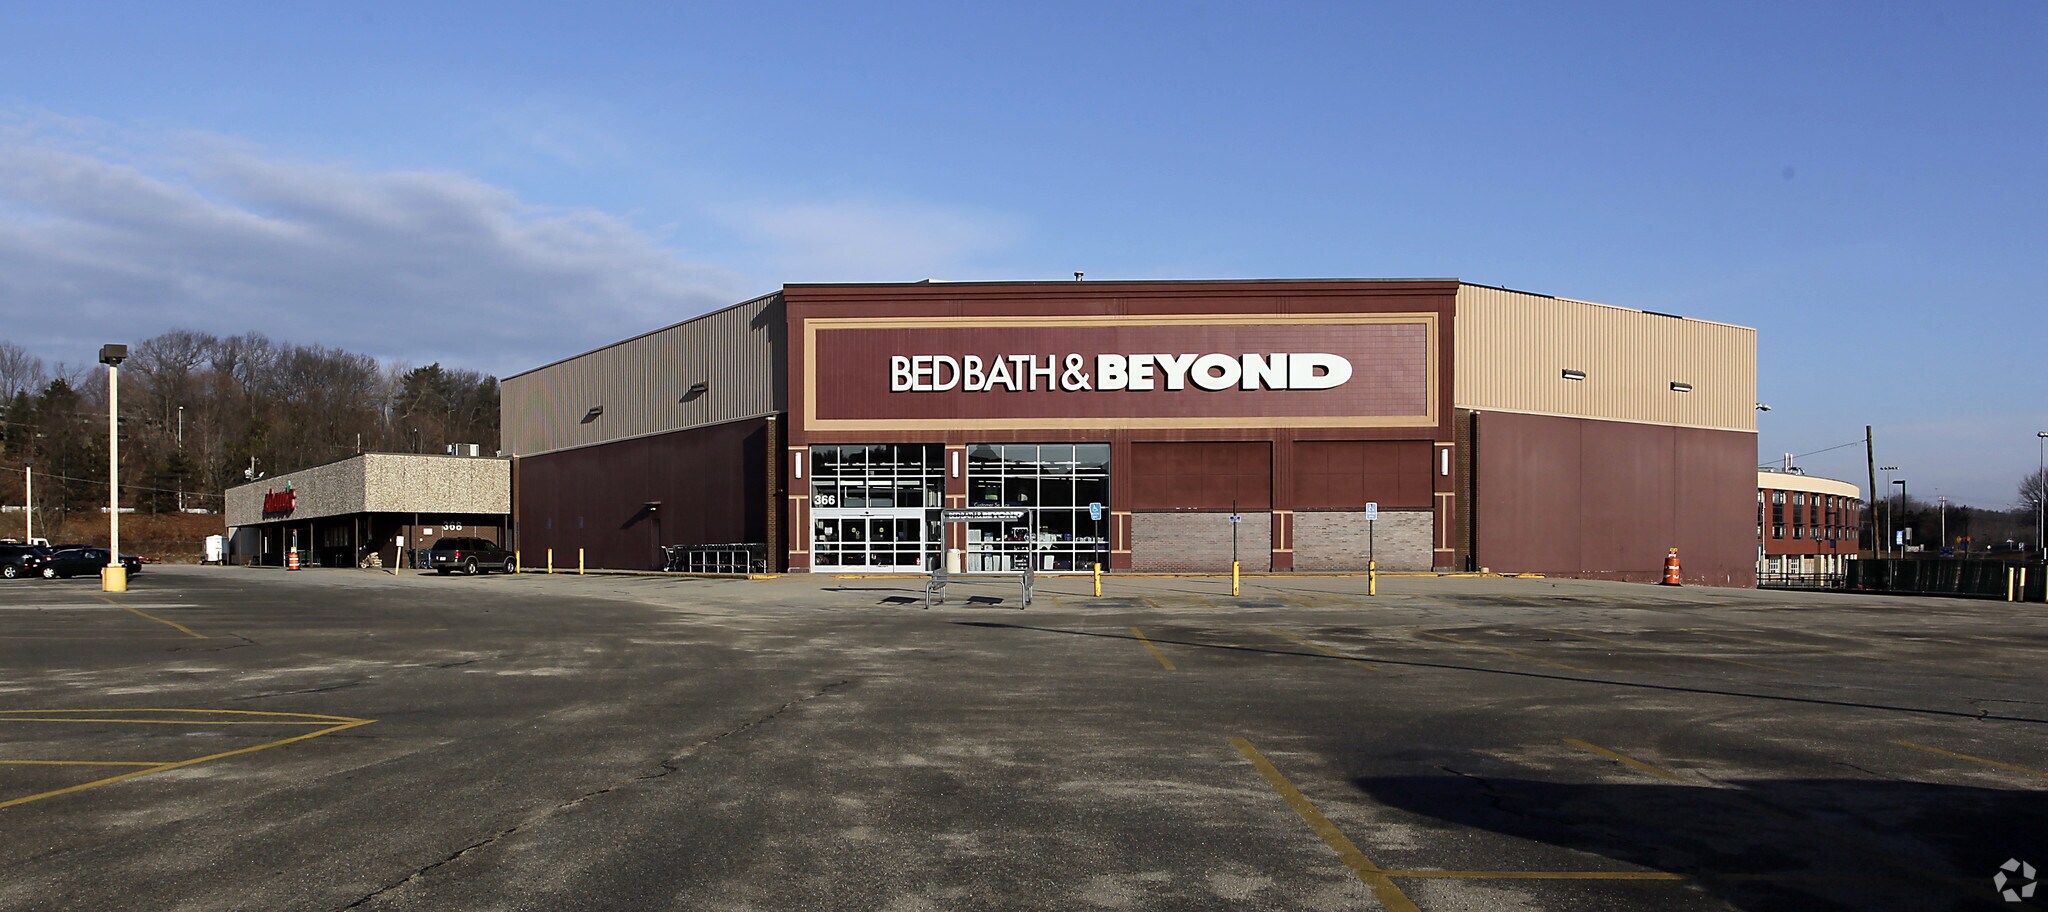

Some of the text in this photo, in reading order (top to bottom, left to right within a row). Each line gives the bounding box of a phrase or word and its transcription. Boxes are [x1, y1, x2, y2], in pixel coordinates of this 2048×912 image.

[891, 352, 1353, 392] BED BATH & BEYOND
[814, 495, 836, 505] 366
[443, 521, 463, 531] 368
